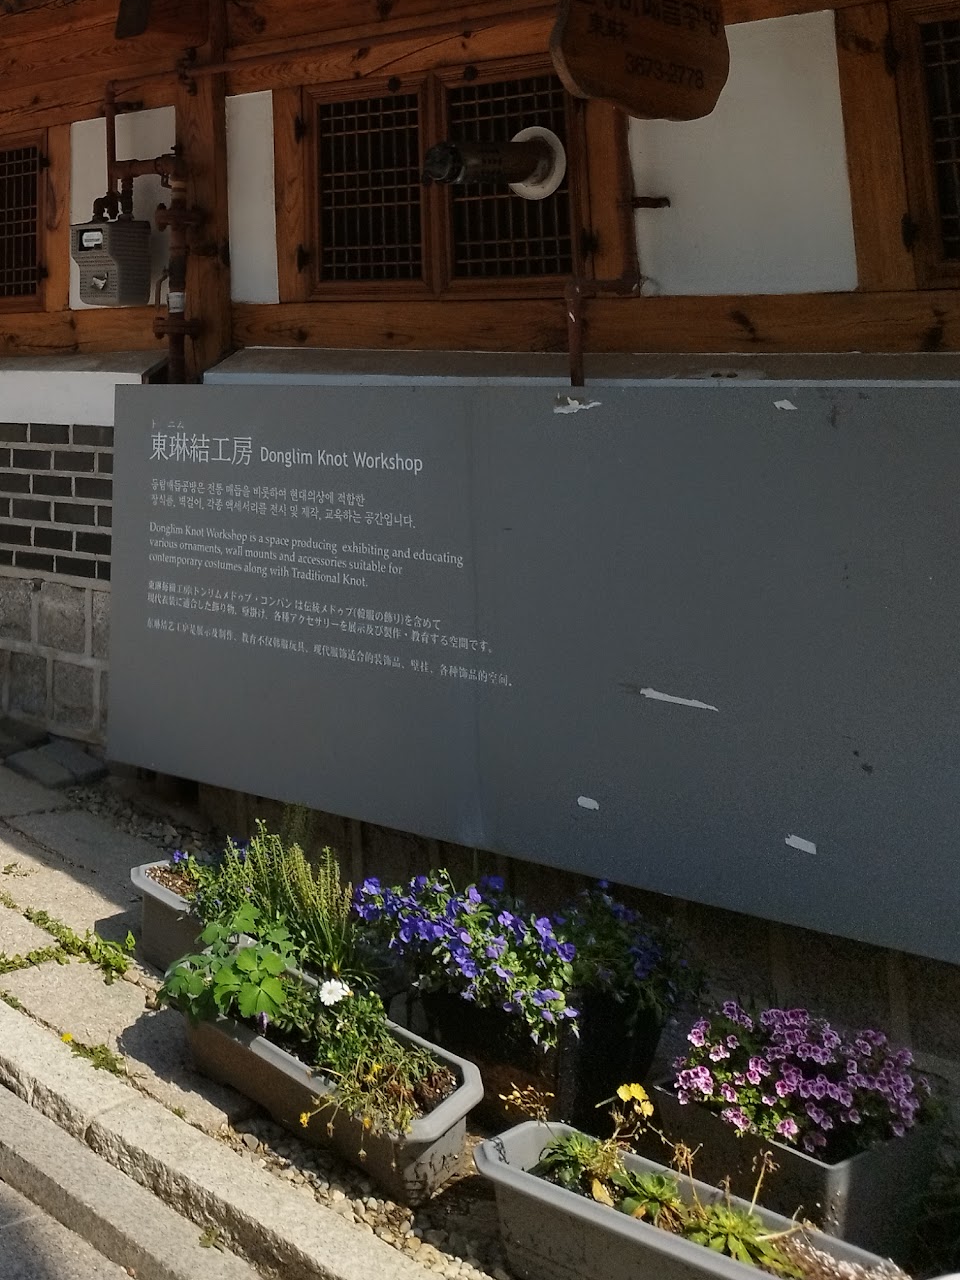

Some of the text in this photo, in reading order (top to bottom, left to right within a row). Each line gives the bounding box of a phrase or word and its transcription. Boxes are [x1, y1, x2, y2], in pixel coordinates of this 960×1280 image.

[149, 431, 423, 476] 東琳結工房 Donglim Knot Workshop
[207, 482, 224, 497] 전통
[226, 484, 251, 498] 매듭을
[253, 485, 287, 500] 비롯하여
[290, 488, 334, 504] 현대의상에
[337, 492, 365, 507] 적합한
[207, 497, 224, 512] 각종
[226, 499, 268, 516] 액세서리를
[269, 503, 288, 517] 전시
[290, 505, 298, 518] 및
[325, 508, 362, 524] 교육하는
[365, 511, 416, 529] 공간입니다.
[149, 521, 464, 568] Donglim Knot Workshop is a space producing exhibiting and educating
[149, 537, 403, 575] various ornaments, wall mounts and accessories suitable for
[148, 553, 369, 588] contemporary costumes along with Traditional Knot.
